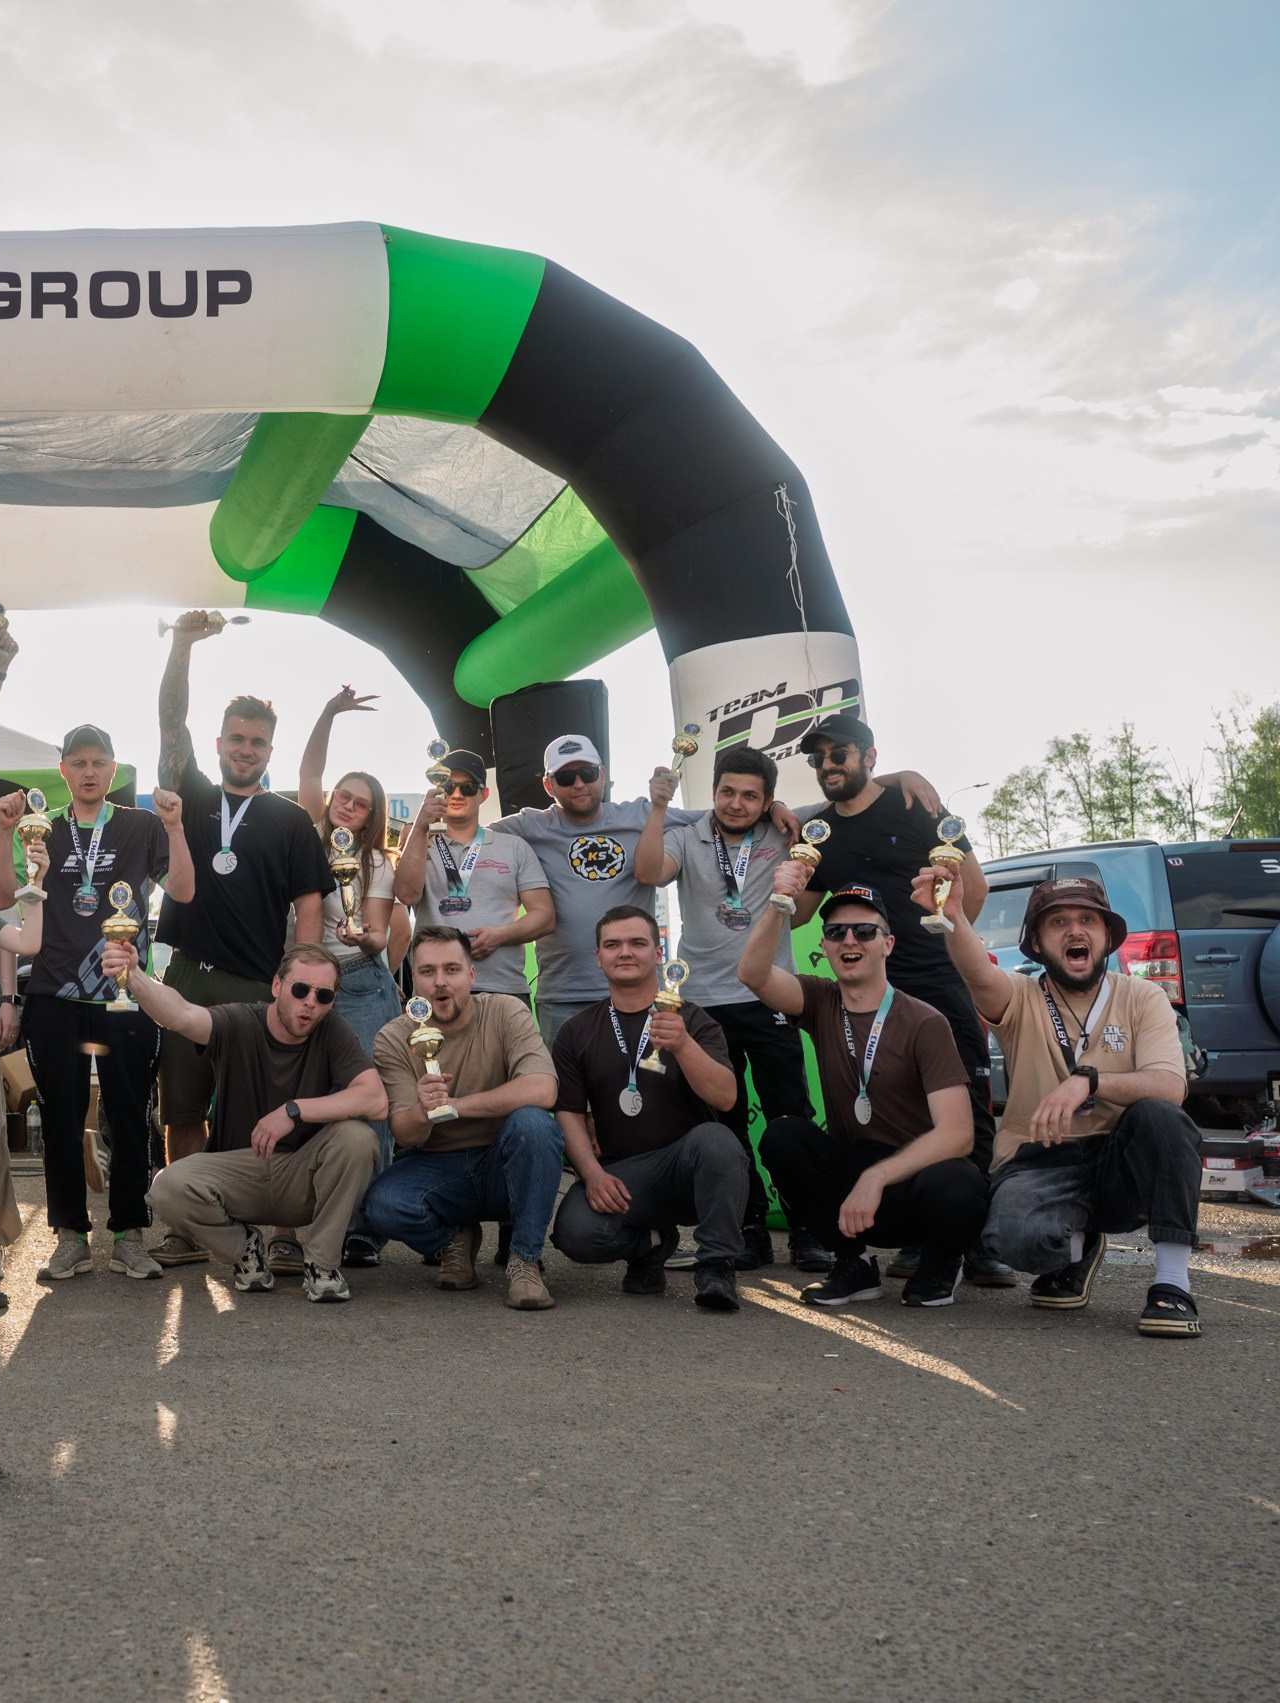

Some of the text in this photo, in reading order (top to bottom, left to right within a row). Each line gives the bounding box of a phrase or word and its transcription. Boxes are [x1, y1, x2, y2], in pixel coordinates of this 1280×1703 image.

[70, 817, 83, 860] АВТОЗВУК
[88, 841, 98, 861] ПРИЗ
[588, 851, 606, 861] KS
[738, 856, 747, 877] ПРИЗ
[609, 1006, 628, 1054] АВТОЗВУК
[1044, 993, 1069, 1047] АВТОЗВУК
[638, 1032, 649, 1055] ПРИЗ
[866, 1035, 877, 1060] ПРИЗ
